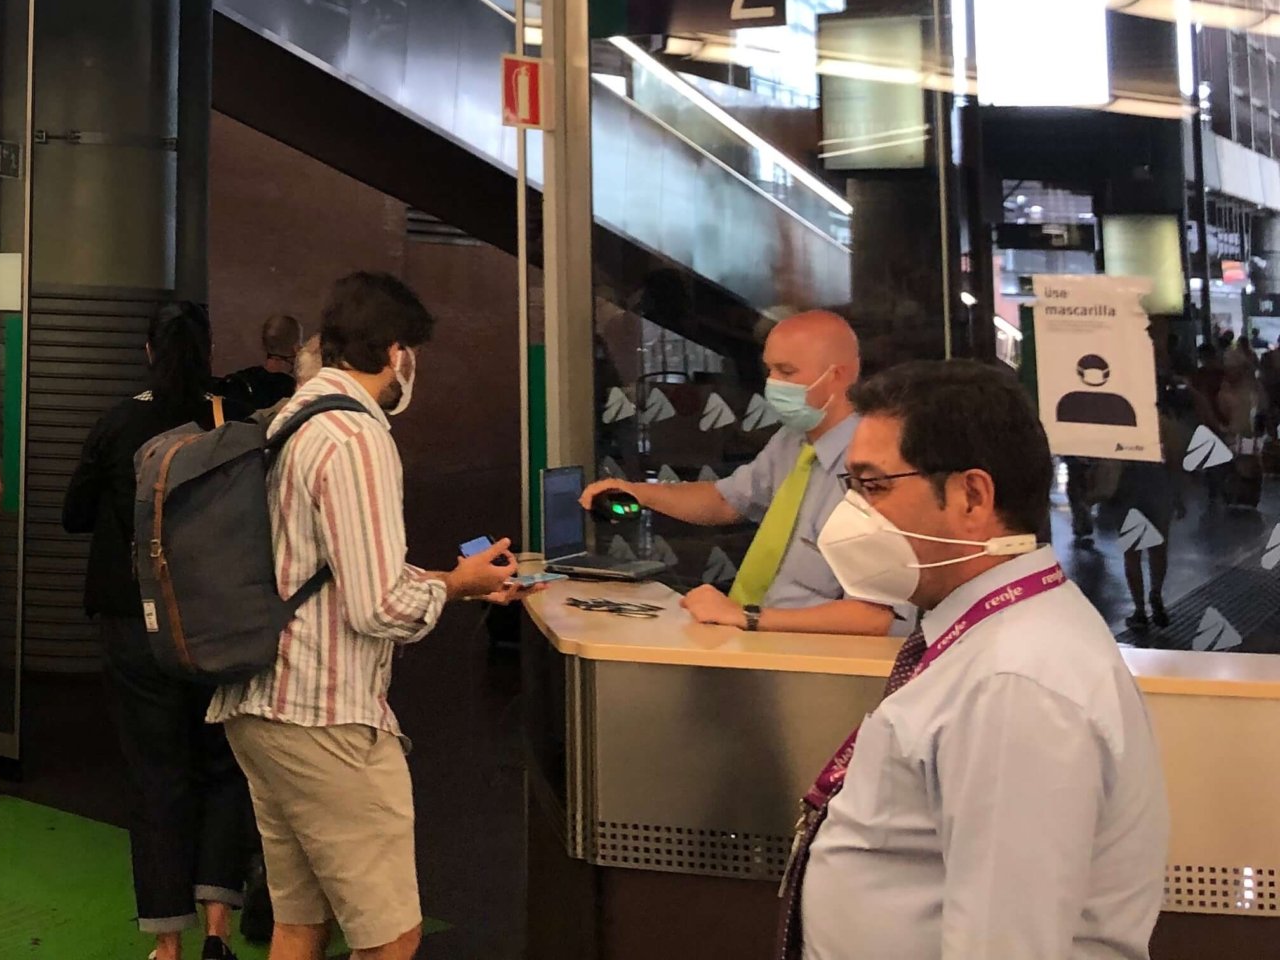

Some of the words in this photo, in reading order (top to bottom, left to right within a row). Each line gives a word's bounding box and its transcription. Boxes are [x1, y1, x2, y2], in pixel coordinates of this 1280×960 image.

[1045, 304, 1116, 317] mascarilla
[1041, 567, 1064, 585] renf
[984, 585, 1024, 610] renfe
[936, 620, 967, 650] renfe
